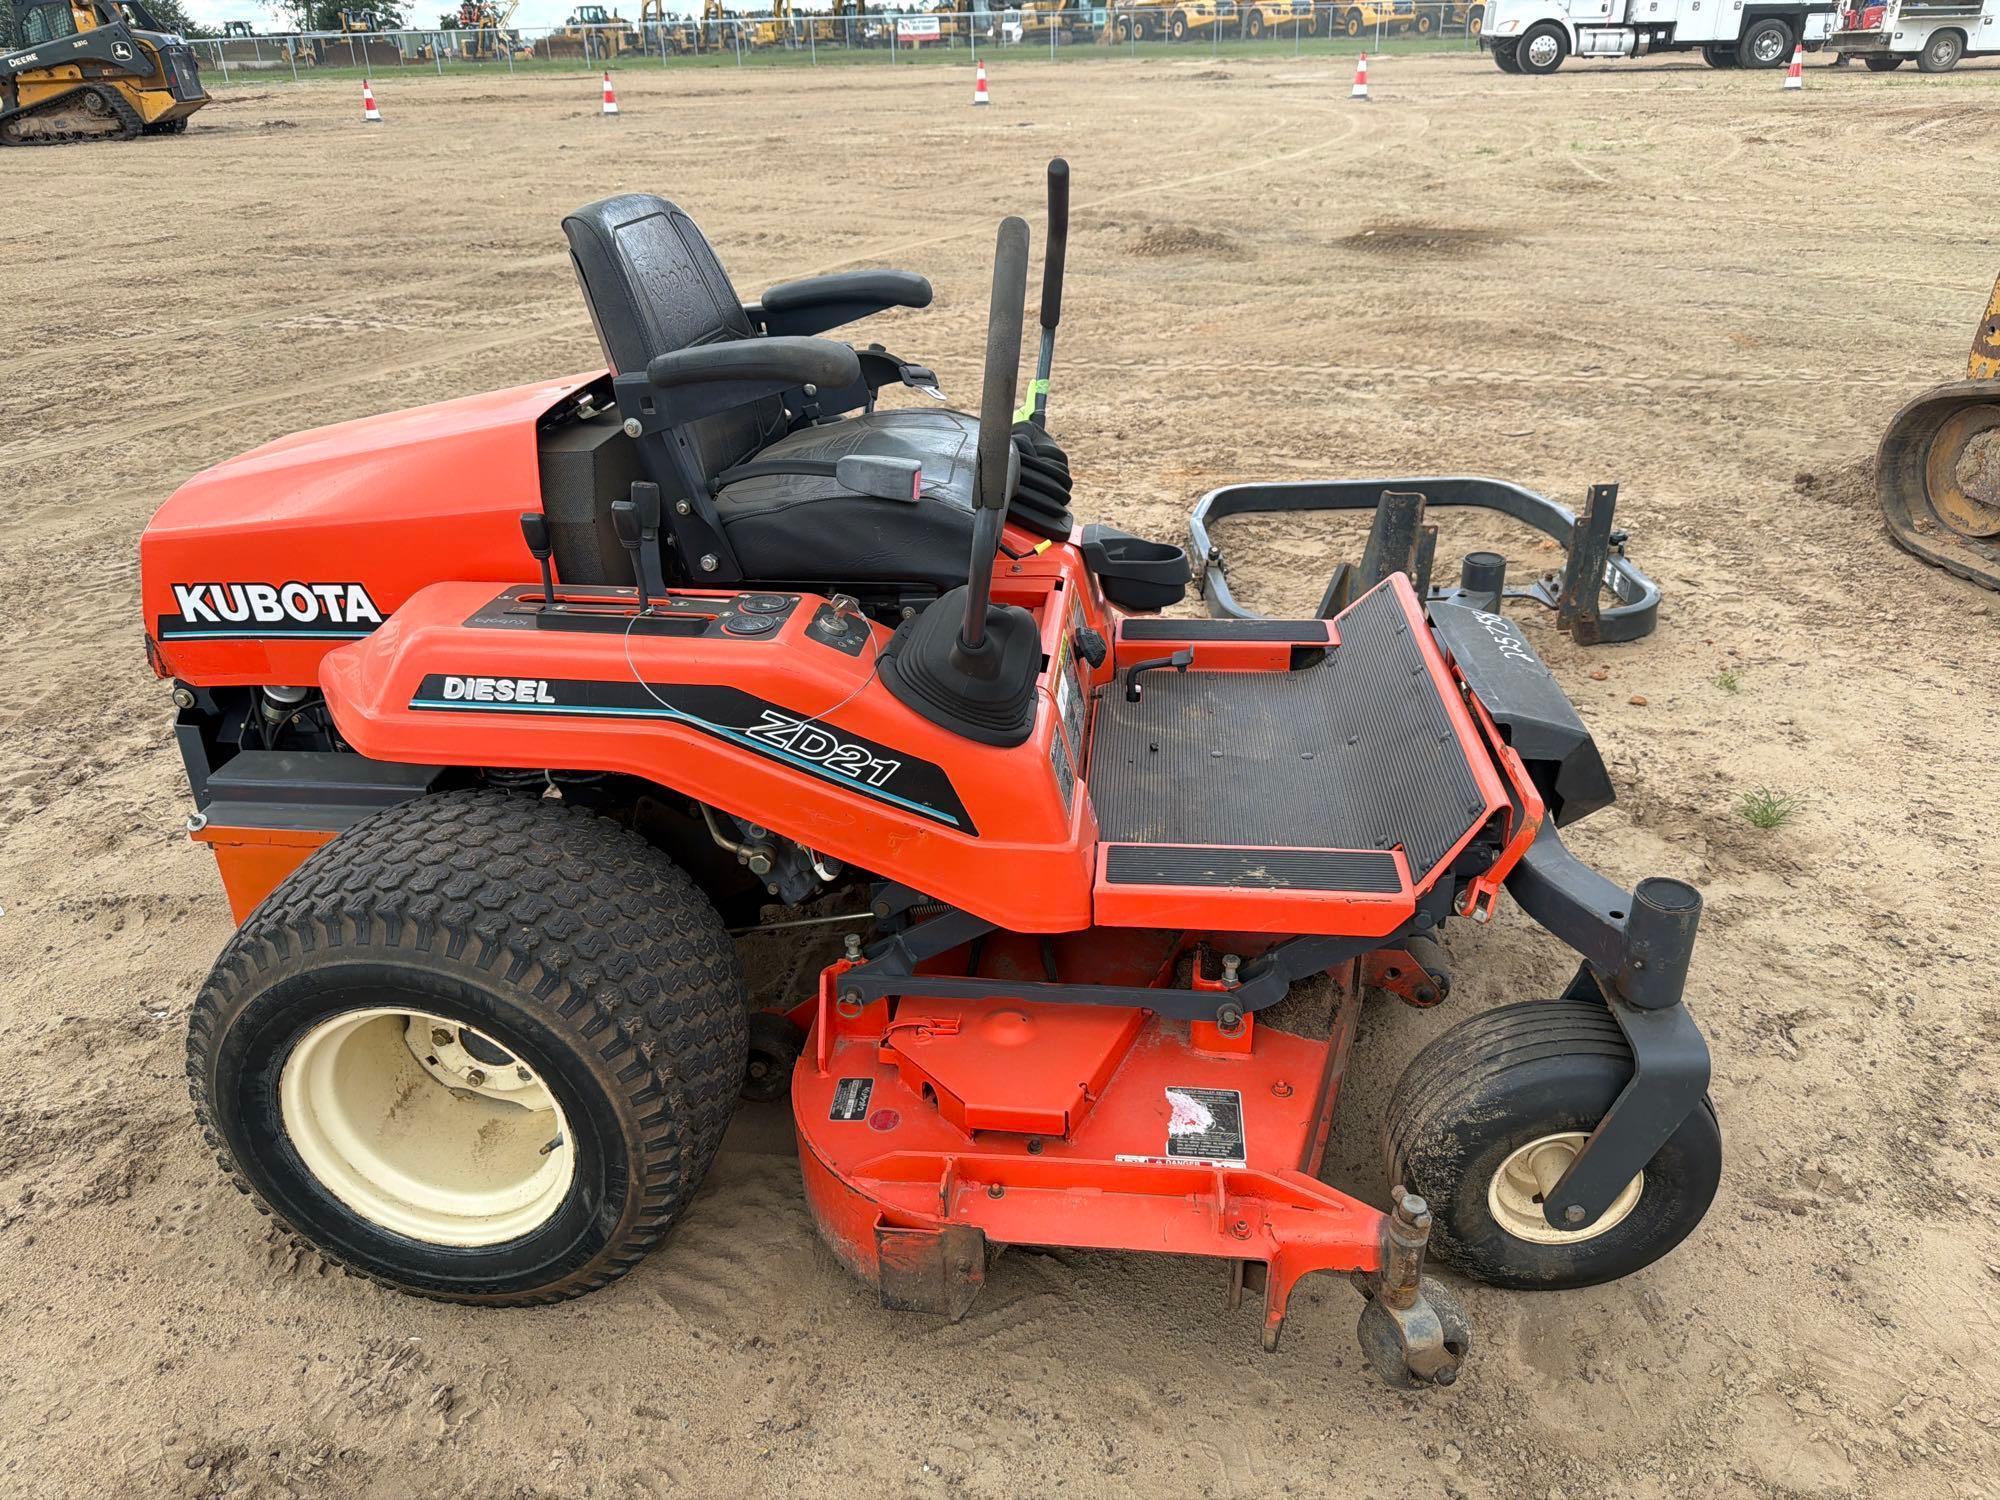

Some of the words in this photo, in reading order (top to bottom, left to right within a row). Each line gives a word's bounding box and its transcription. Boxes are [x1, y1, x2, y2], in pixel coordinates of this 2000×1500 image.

[8, 53, 38, 67] DEERE
[173, 583, 383, 623] KUBOTA
[443, 676, 556, 704] DIESEL
[745, 709, 901, 787] ZD21
